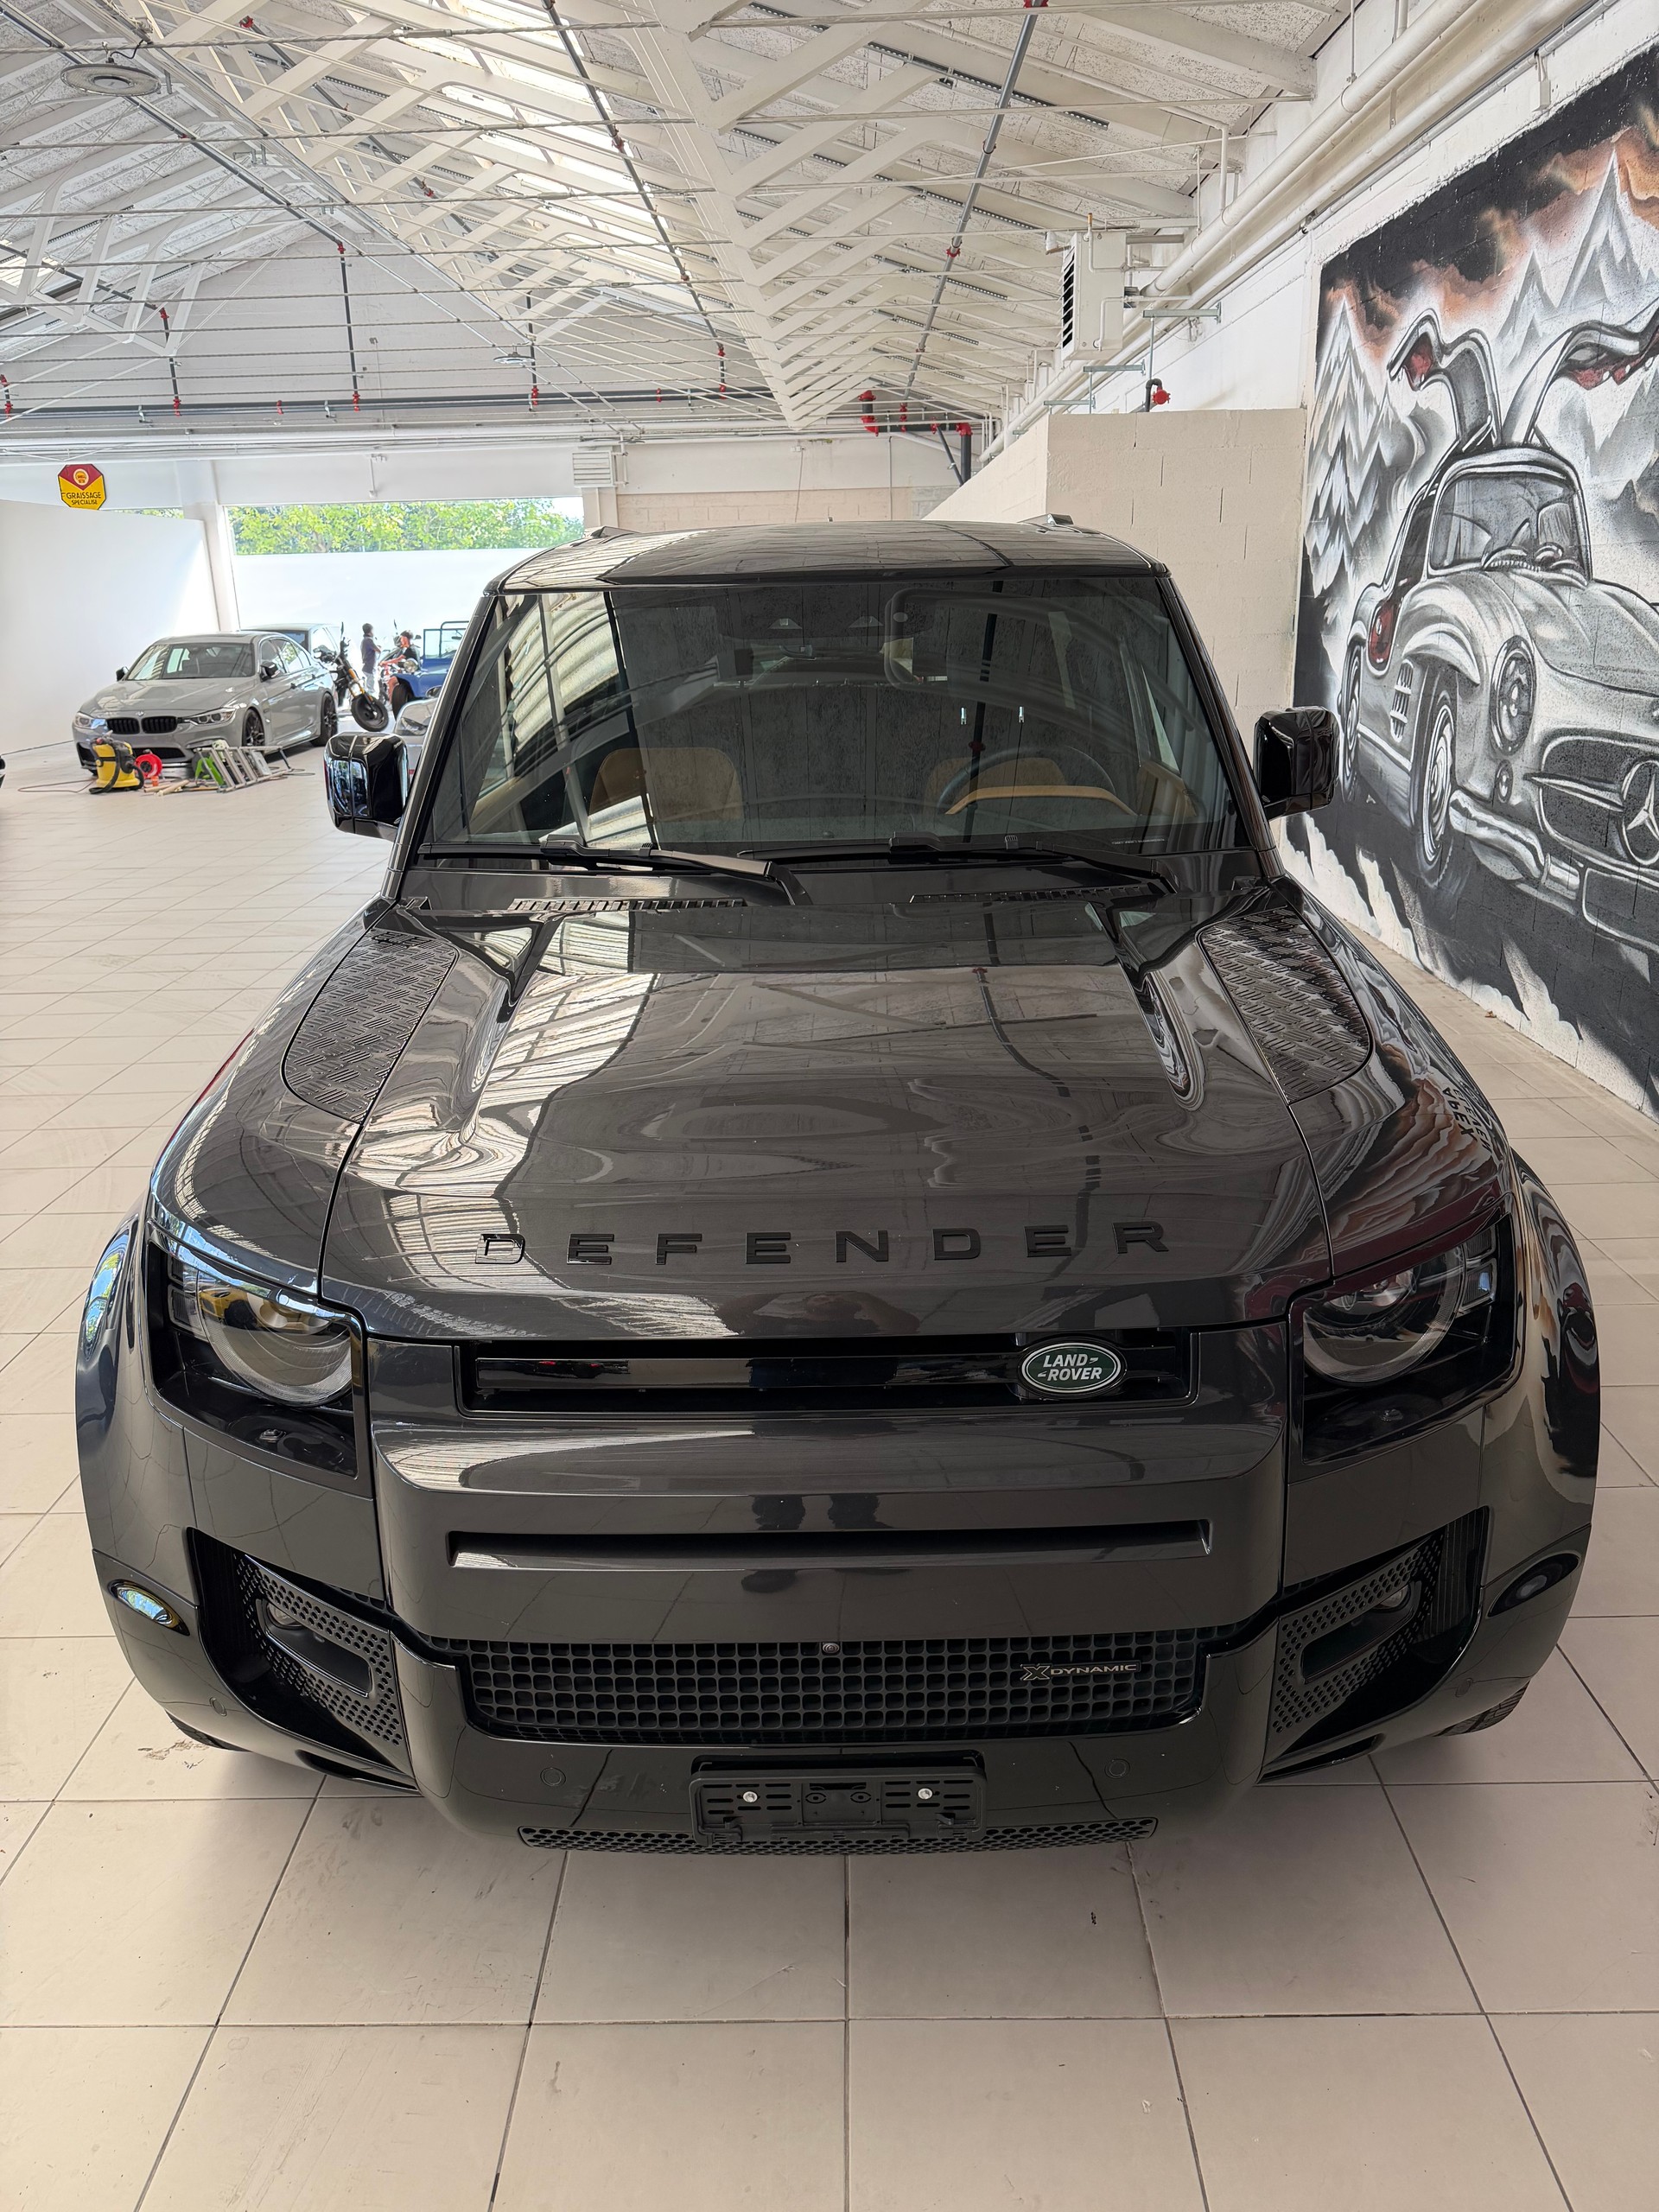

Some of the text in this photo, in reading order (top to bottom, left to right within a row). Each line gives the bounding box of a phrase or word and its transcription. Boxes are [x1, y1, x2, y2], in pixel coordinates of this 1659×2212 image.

[475, 1221, 1169, 1265] DEFENDER
[1043, 1353, 1089, 1368] LAND
[1046, 1367, 1103, 1382] ROVER
